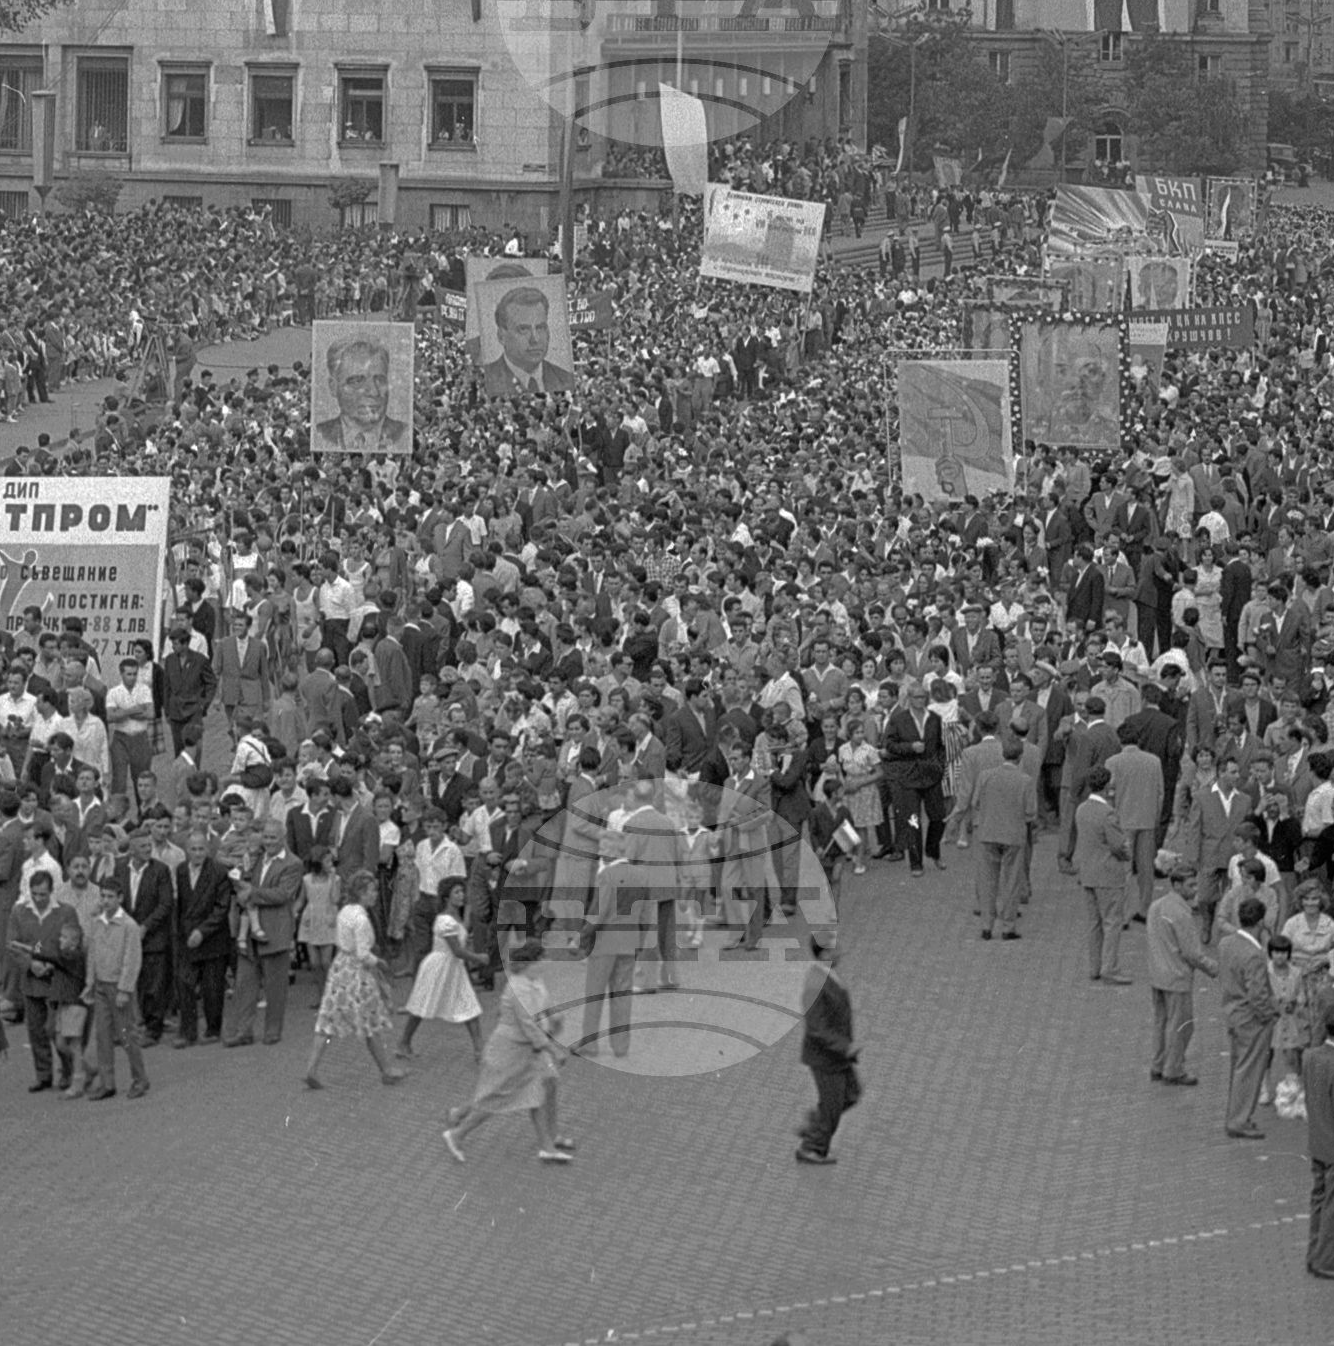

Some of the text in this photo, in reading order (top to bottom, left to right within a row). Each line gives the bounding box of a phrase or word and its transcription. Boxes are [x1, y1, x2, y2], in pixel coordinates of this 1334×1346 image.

[1155, 177, 1197, 202] БКП
[1158, 198, 1197, 213] СЛАВА
[1176, 313, 1190, 328] ЦК
[1194, 314, 1207, 326] НА
[1211, 311, 1241, 326] КПСС
[3, 482, 40, 499] ДИП
[57, 593, 145, 610] ПОСТИГНА:
